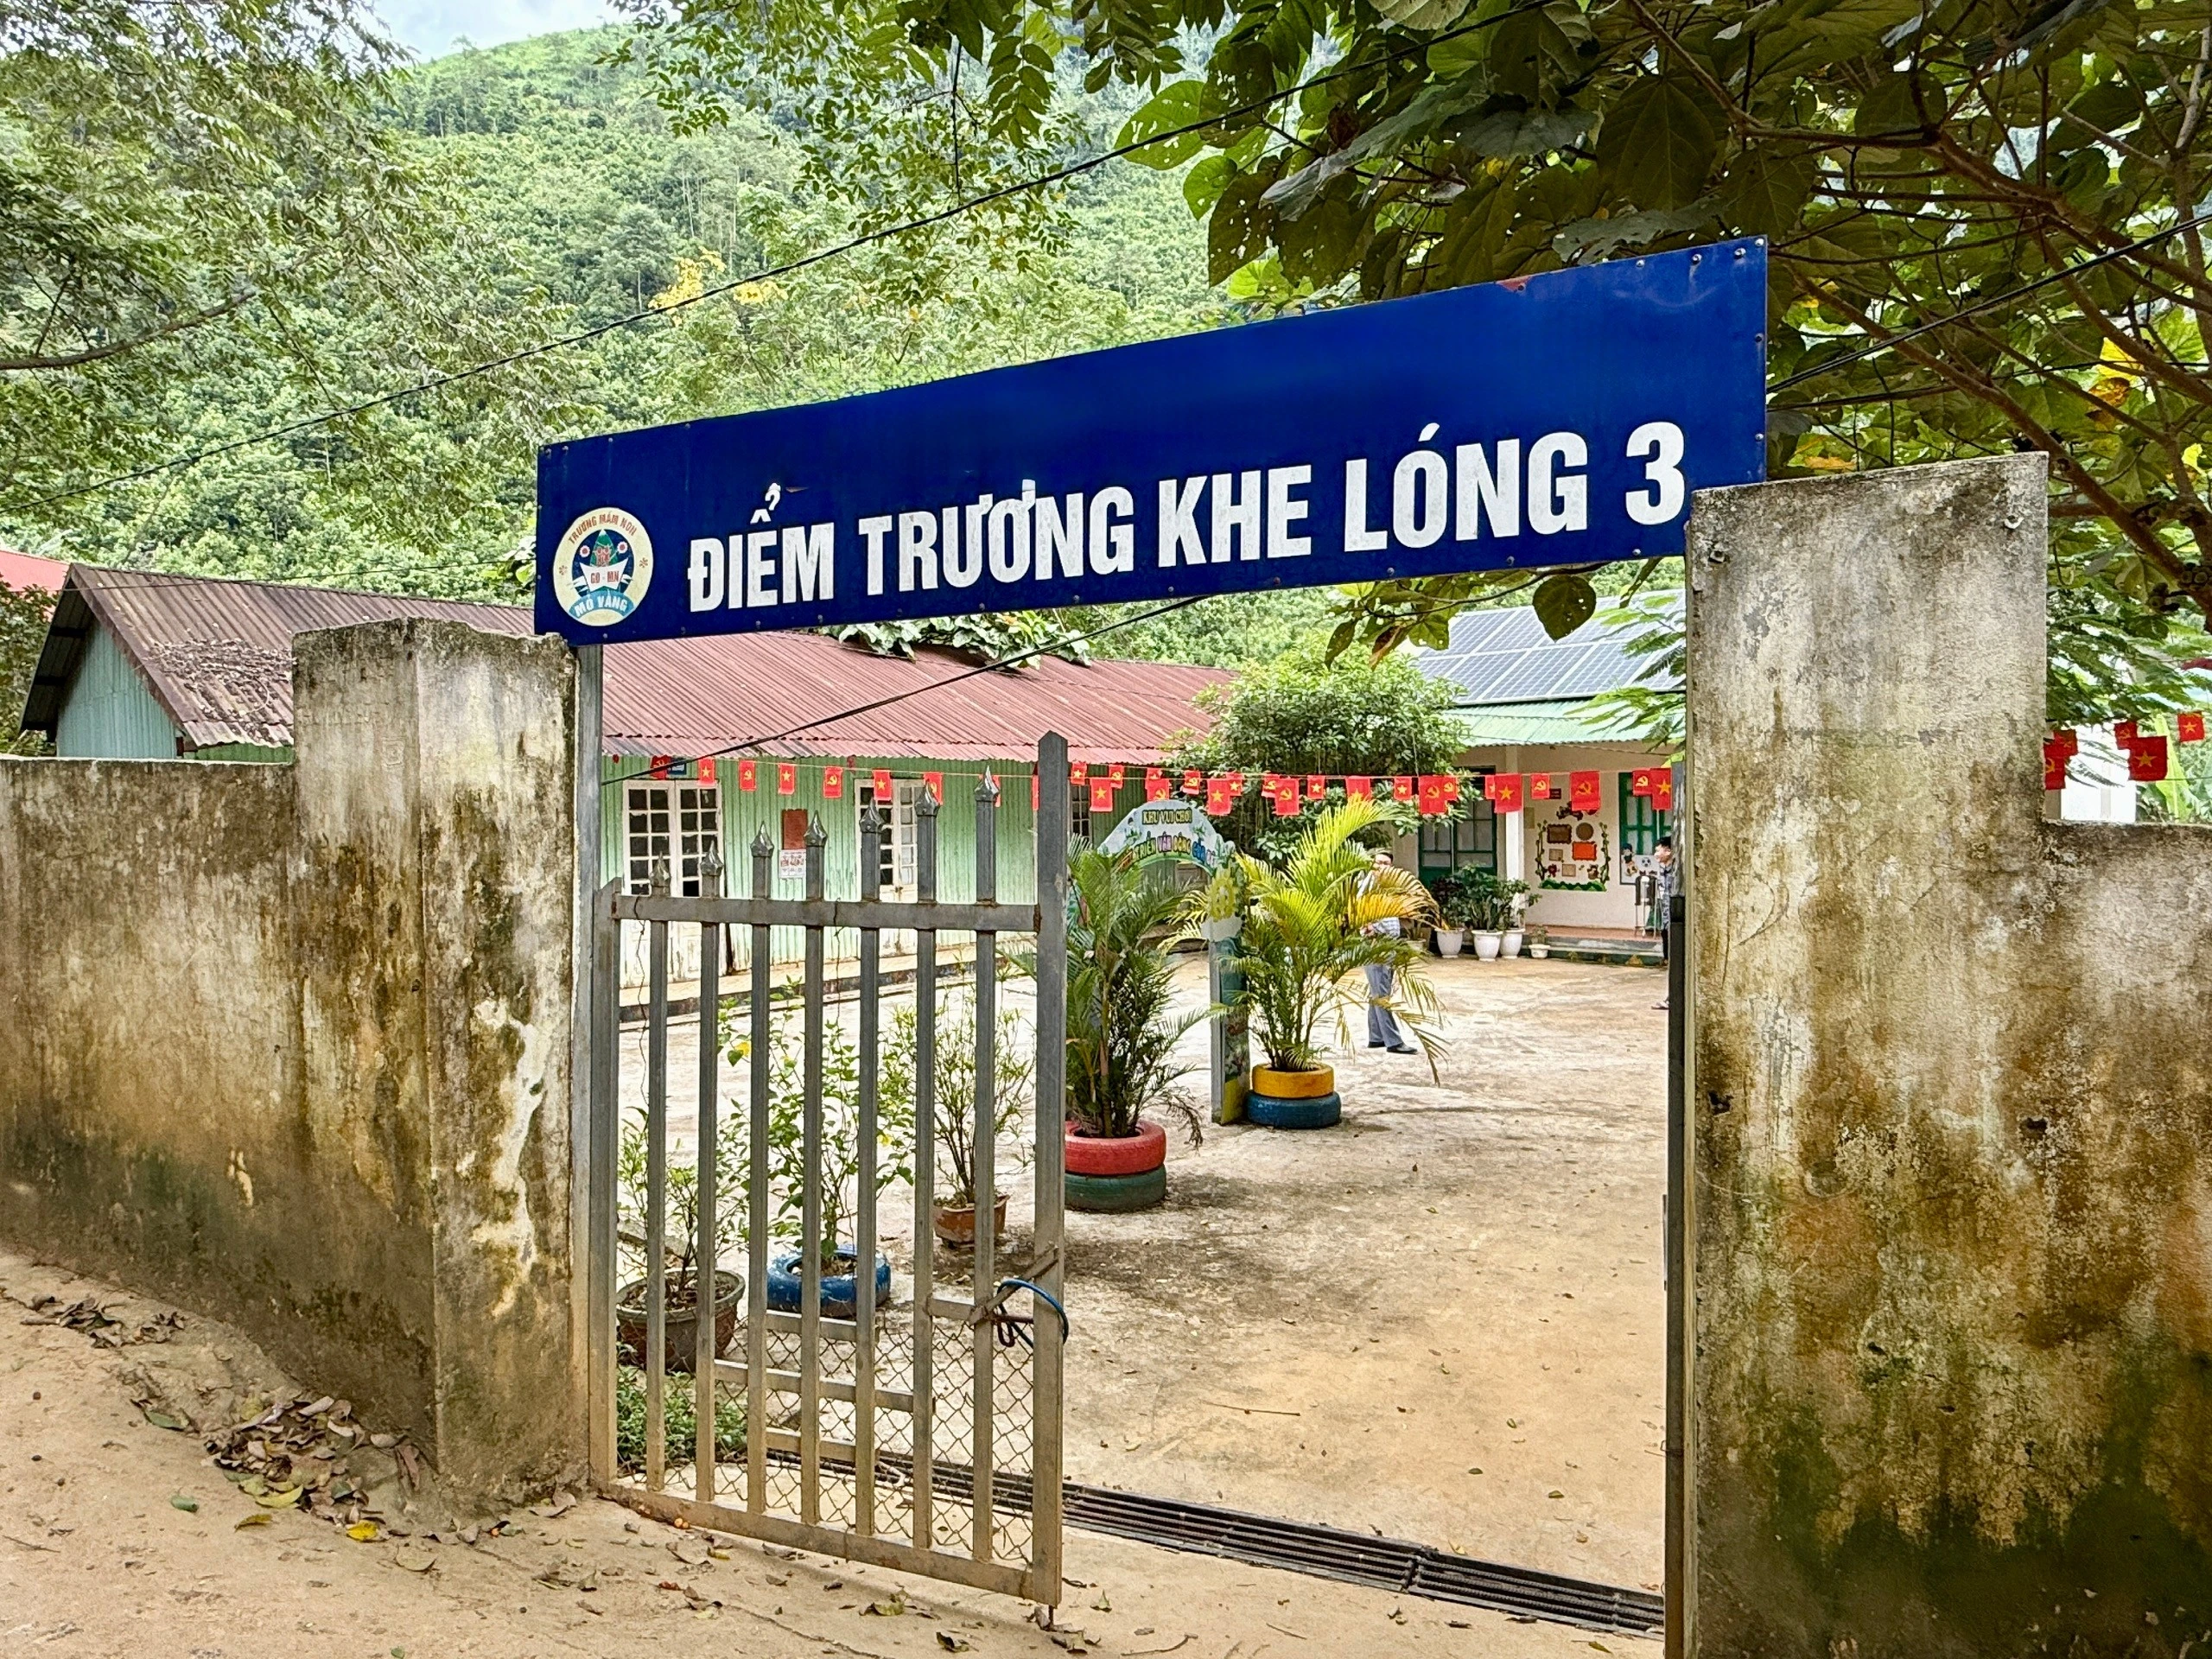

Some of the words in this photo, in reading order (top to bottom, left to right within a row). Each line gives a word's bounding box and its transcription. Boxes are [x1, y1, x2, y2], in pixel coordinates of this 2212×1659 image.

[620, 518, 637, 536] NON
[687, 482, 835, 612] ĐIỂM
[1158, 465, 1312, 568] KHE
[1344, 423, 1588, 552] LÓNG
[1625, 422, 1685, 525] 3
